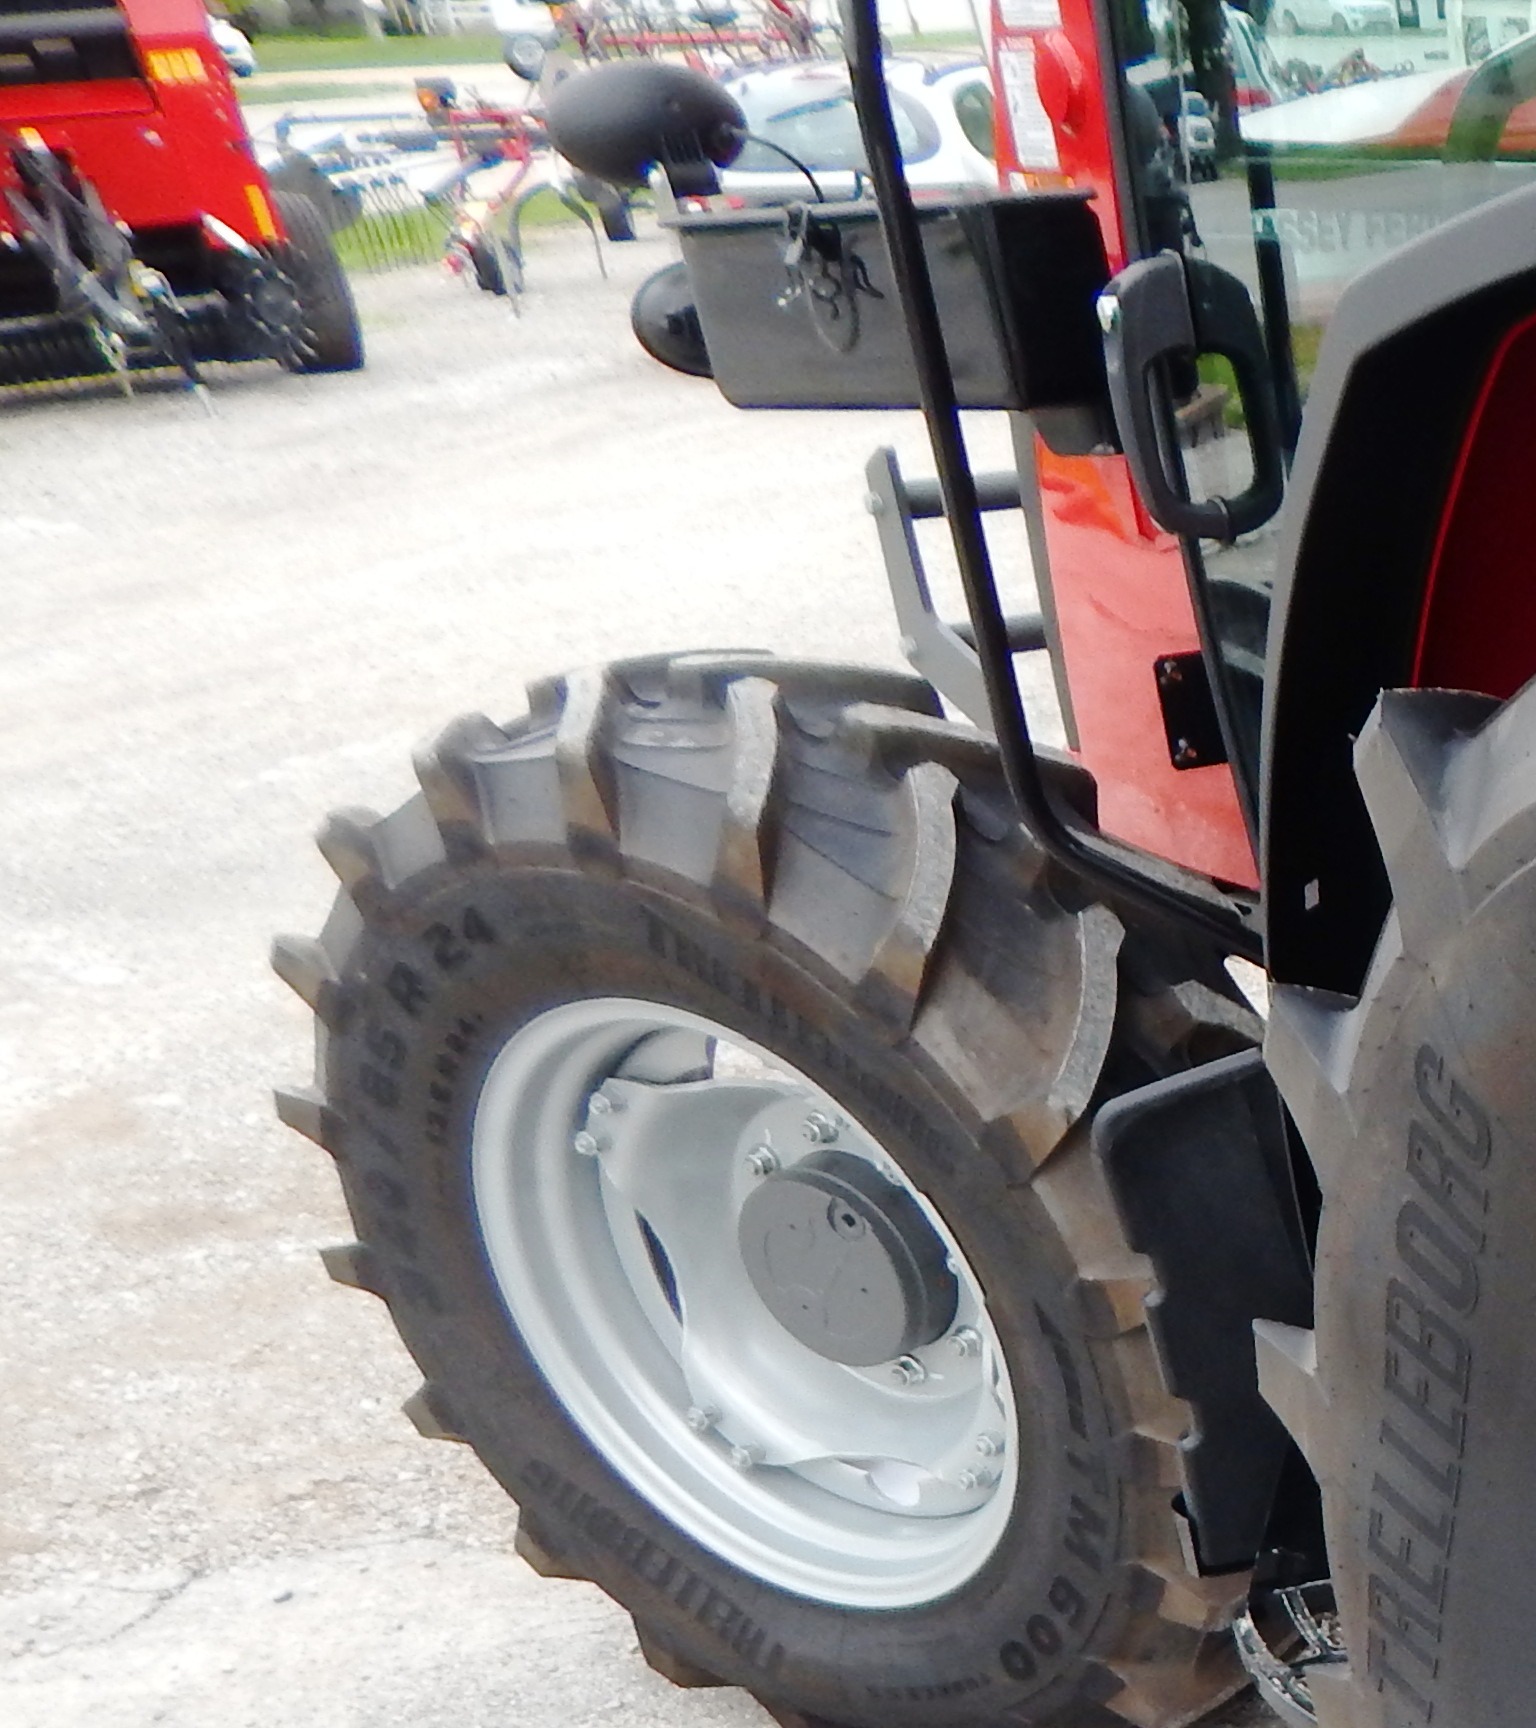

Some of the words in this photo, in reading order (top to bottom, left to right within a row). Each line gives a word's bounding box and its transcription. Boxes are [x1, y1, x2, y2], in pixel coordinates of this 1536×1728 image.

[1366, 1042, 1492, 1722] TRELLEBORG
[1063, 1448, 1110, 1574] TM
[1001, 1574, 1087, 1683] 600
